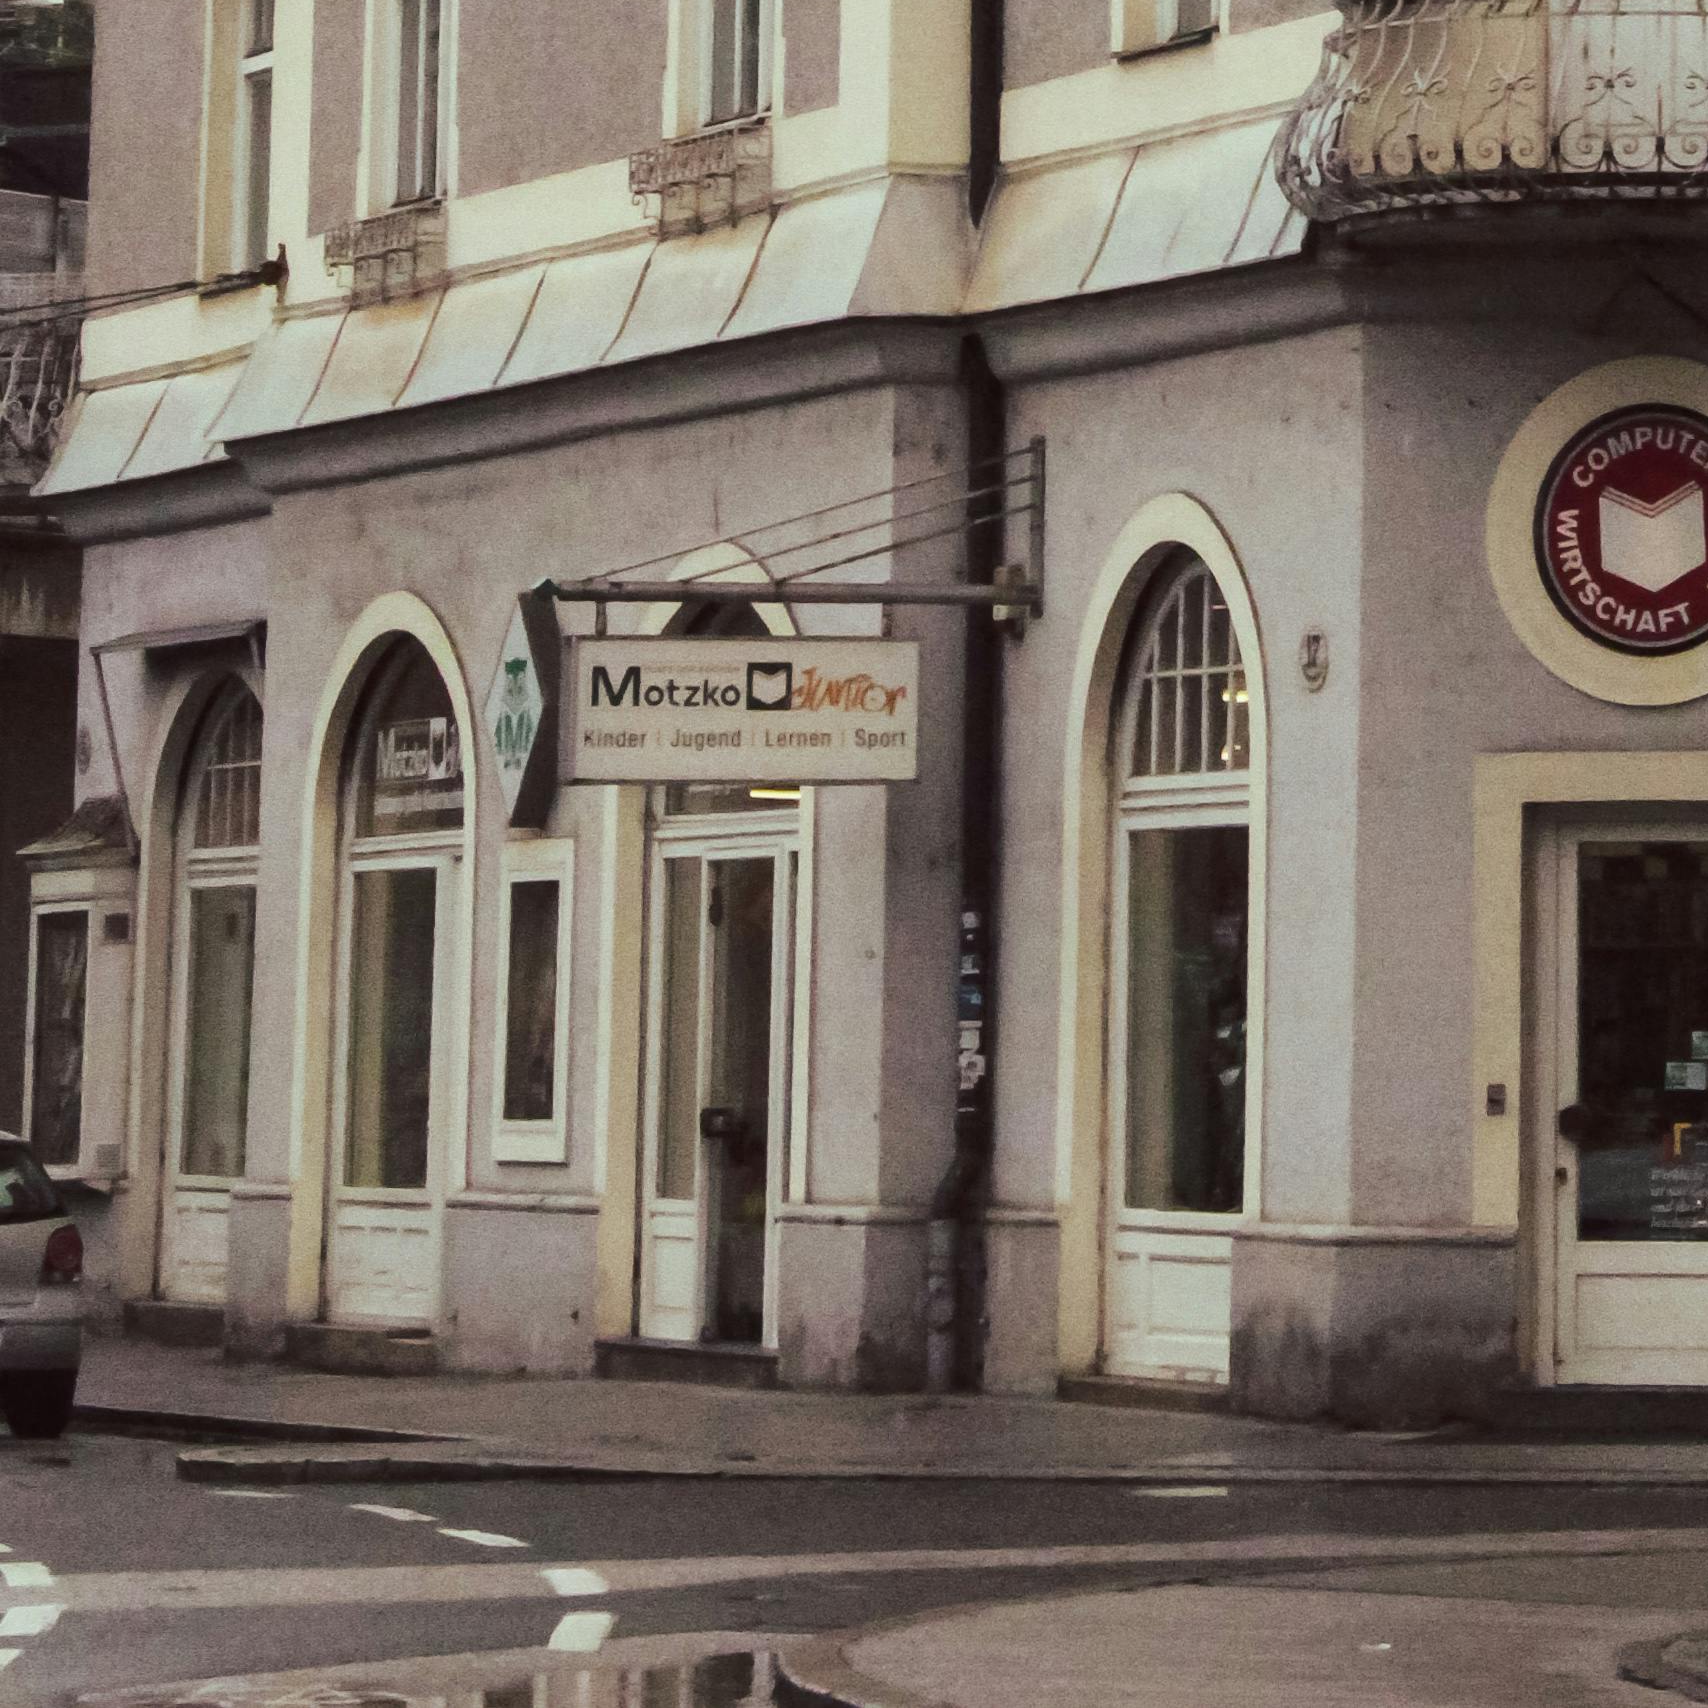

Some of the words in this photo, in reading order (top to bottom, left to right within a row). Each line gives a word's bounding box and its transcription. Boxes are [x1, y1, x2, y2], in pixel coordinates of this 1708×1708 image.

[1556, 508, 1691, 633] WIRTSCHAFT
[590, 665, 741, 707] Motzko
[584, 728, 648, 748] Kinder
[670, 728, 742, 752] Jugend
[765, 727, 832, 748] Lernen
[854, 727, 906, 750] Sport
